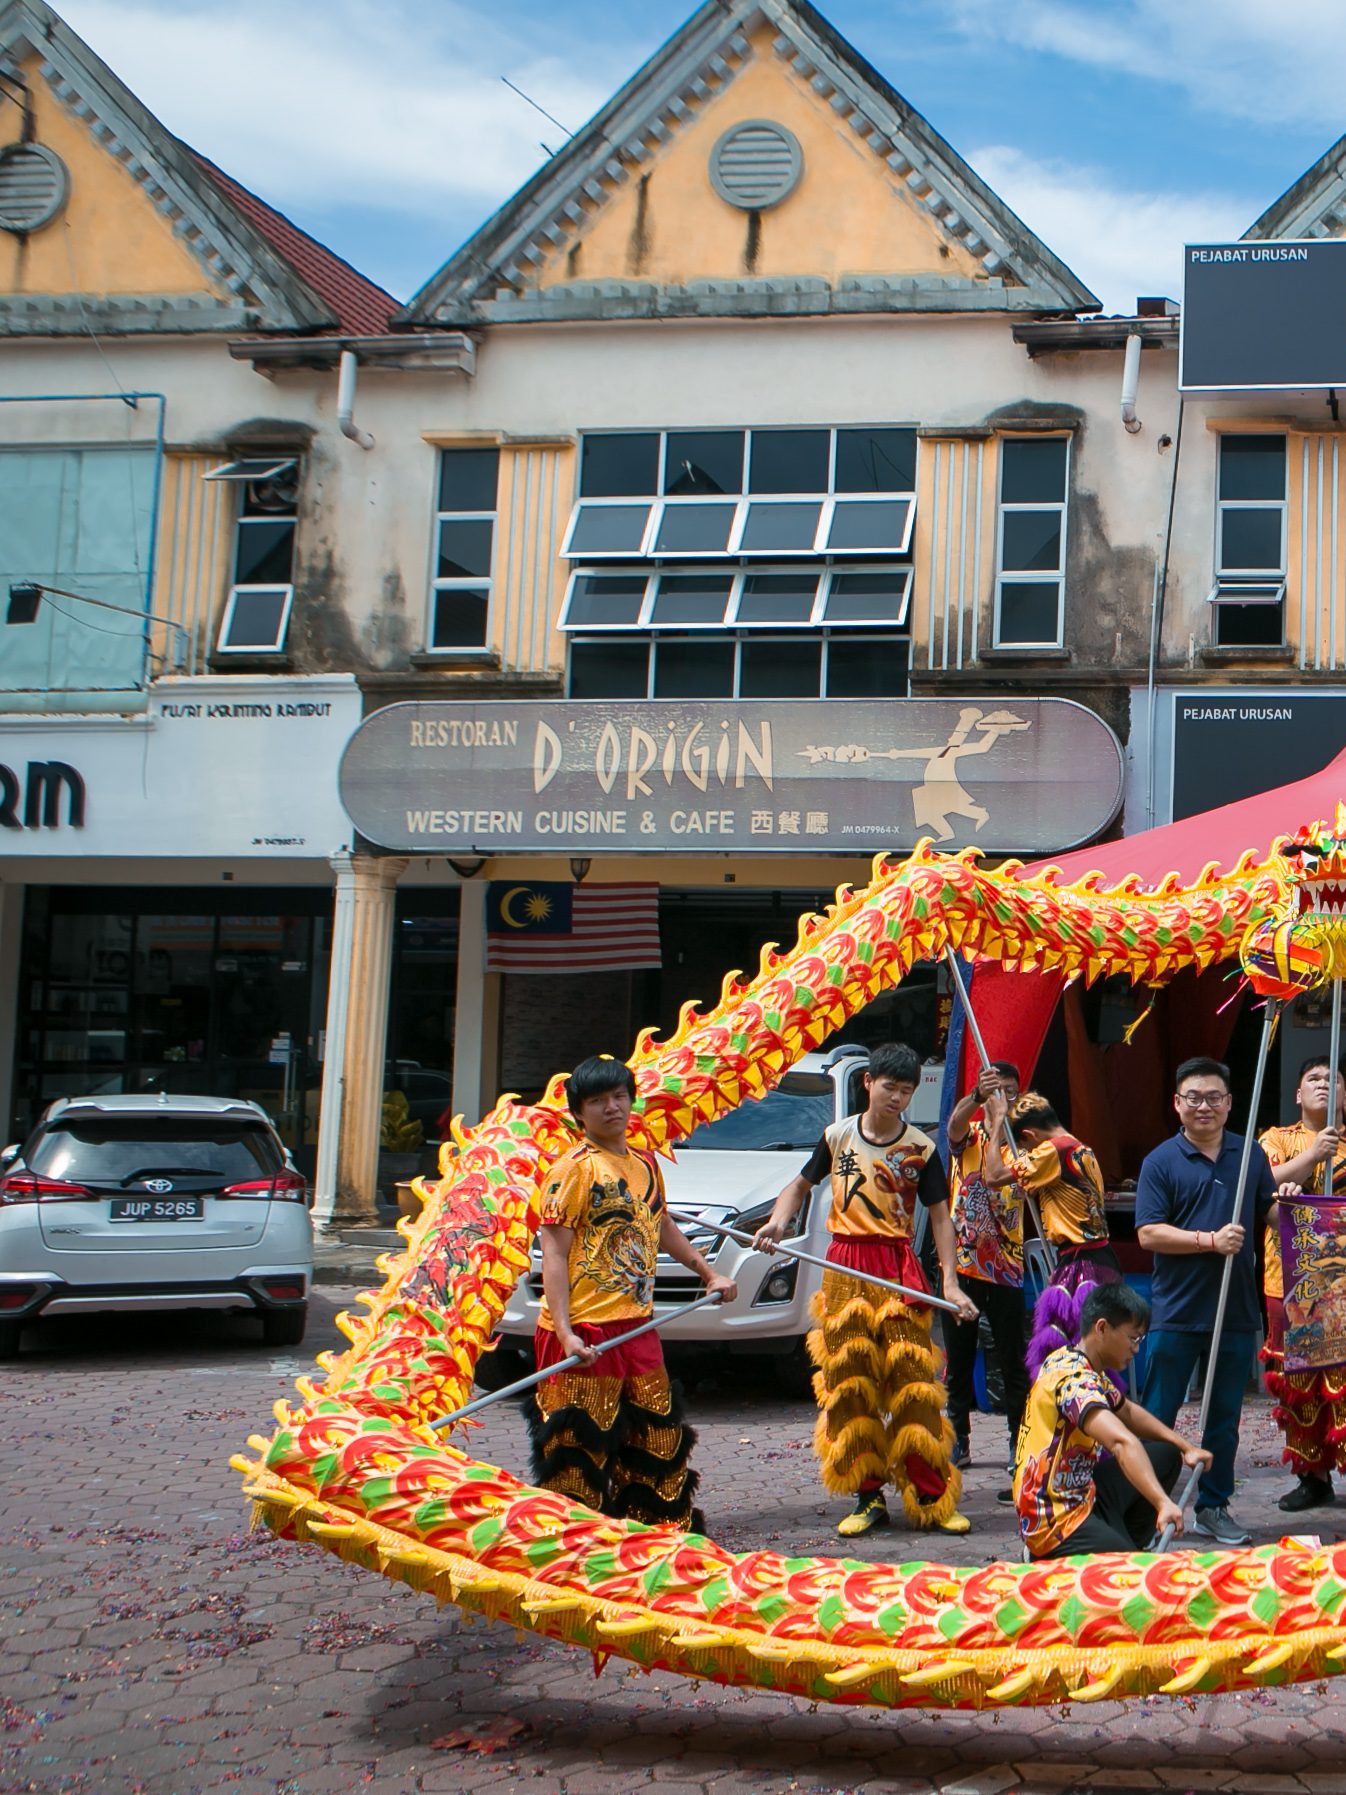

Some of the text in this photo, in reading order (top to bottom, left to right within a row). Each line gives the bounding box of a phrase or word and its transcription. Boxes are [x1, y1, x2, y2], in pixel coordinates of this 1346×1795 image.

[1191, 248, 1308, 263] PEJABAT URUSAN
[276, 703, 332, 717] RAMBUT
[1183, 708, 1292, 720] PEJABAT URUSAN
[410, 720, 519, 747] RESTORAN
[406, 810, 830, 835] WESTERN CUISINE & CAFE 西餐廳
[834, 1150, 887, 1220] 華人
[120, 1201, 197, 1216] JUP 5265
[1292, 1207, 1321, 1302] 傳承文化
